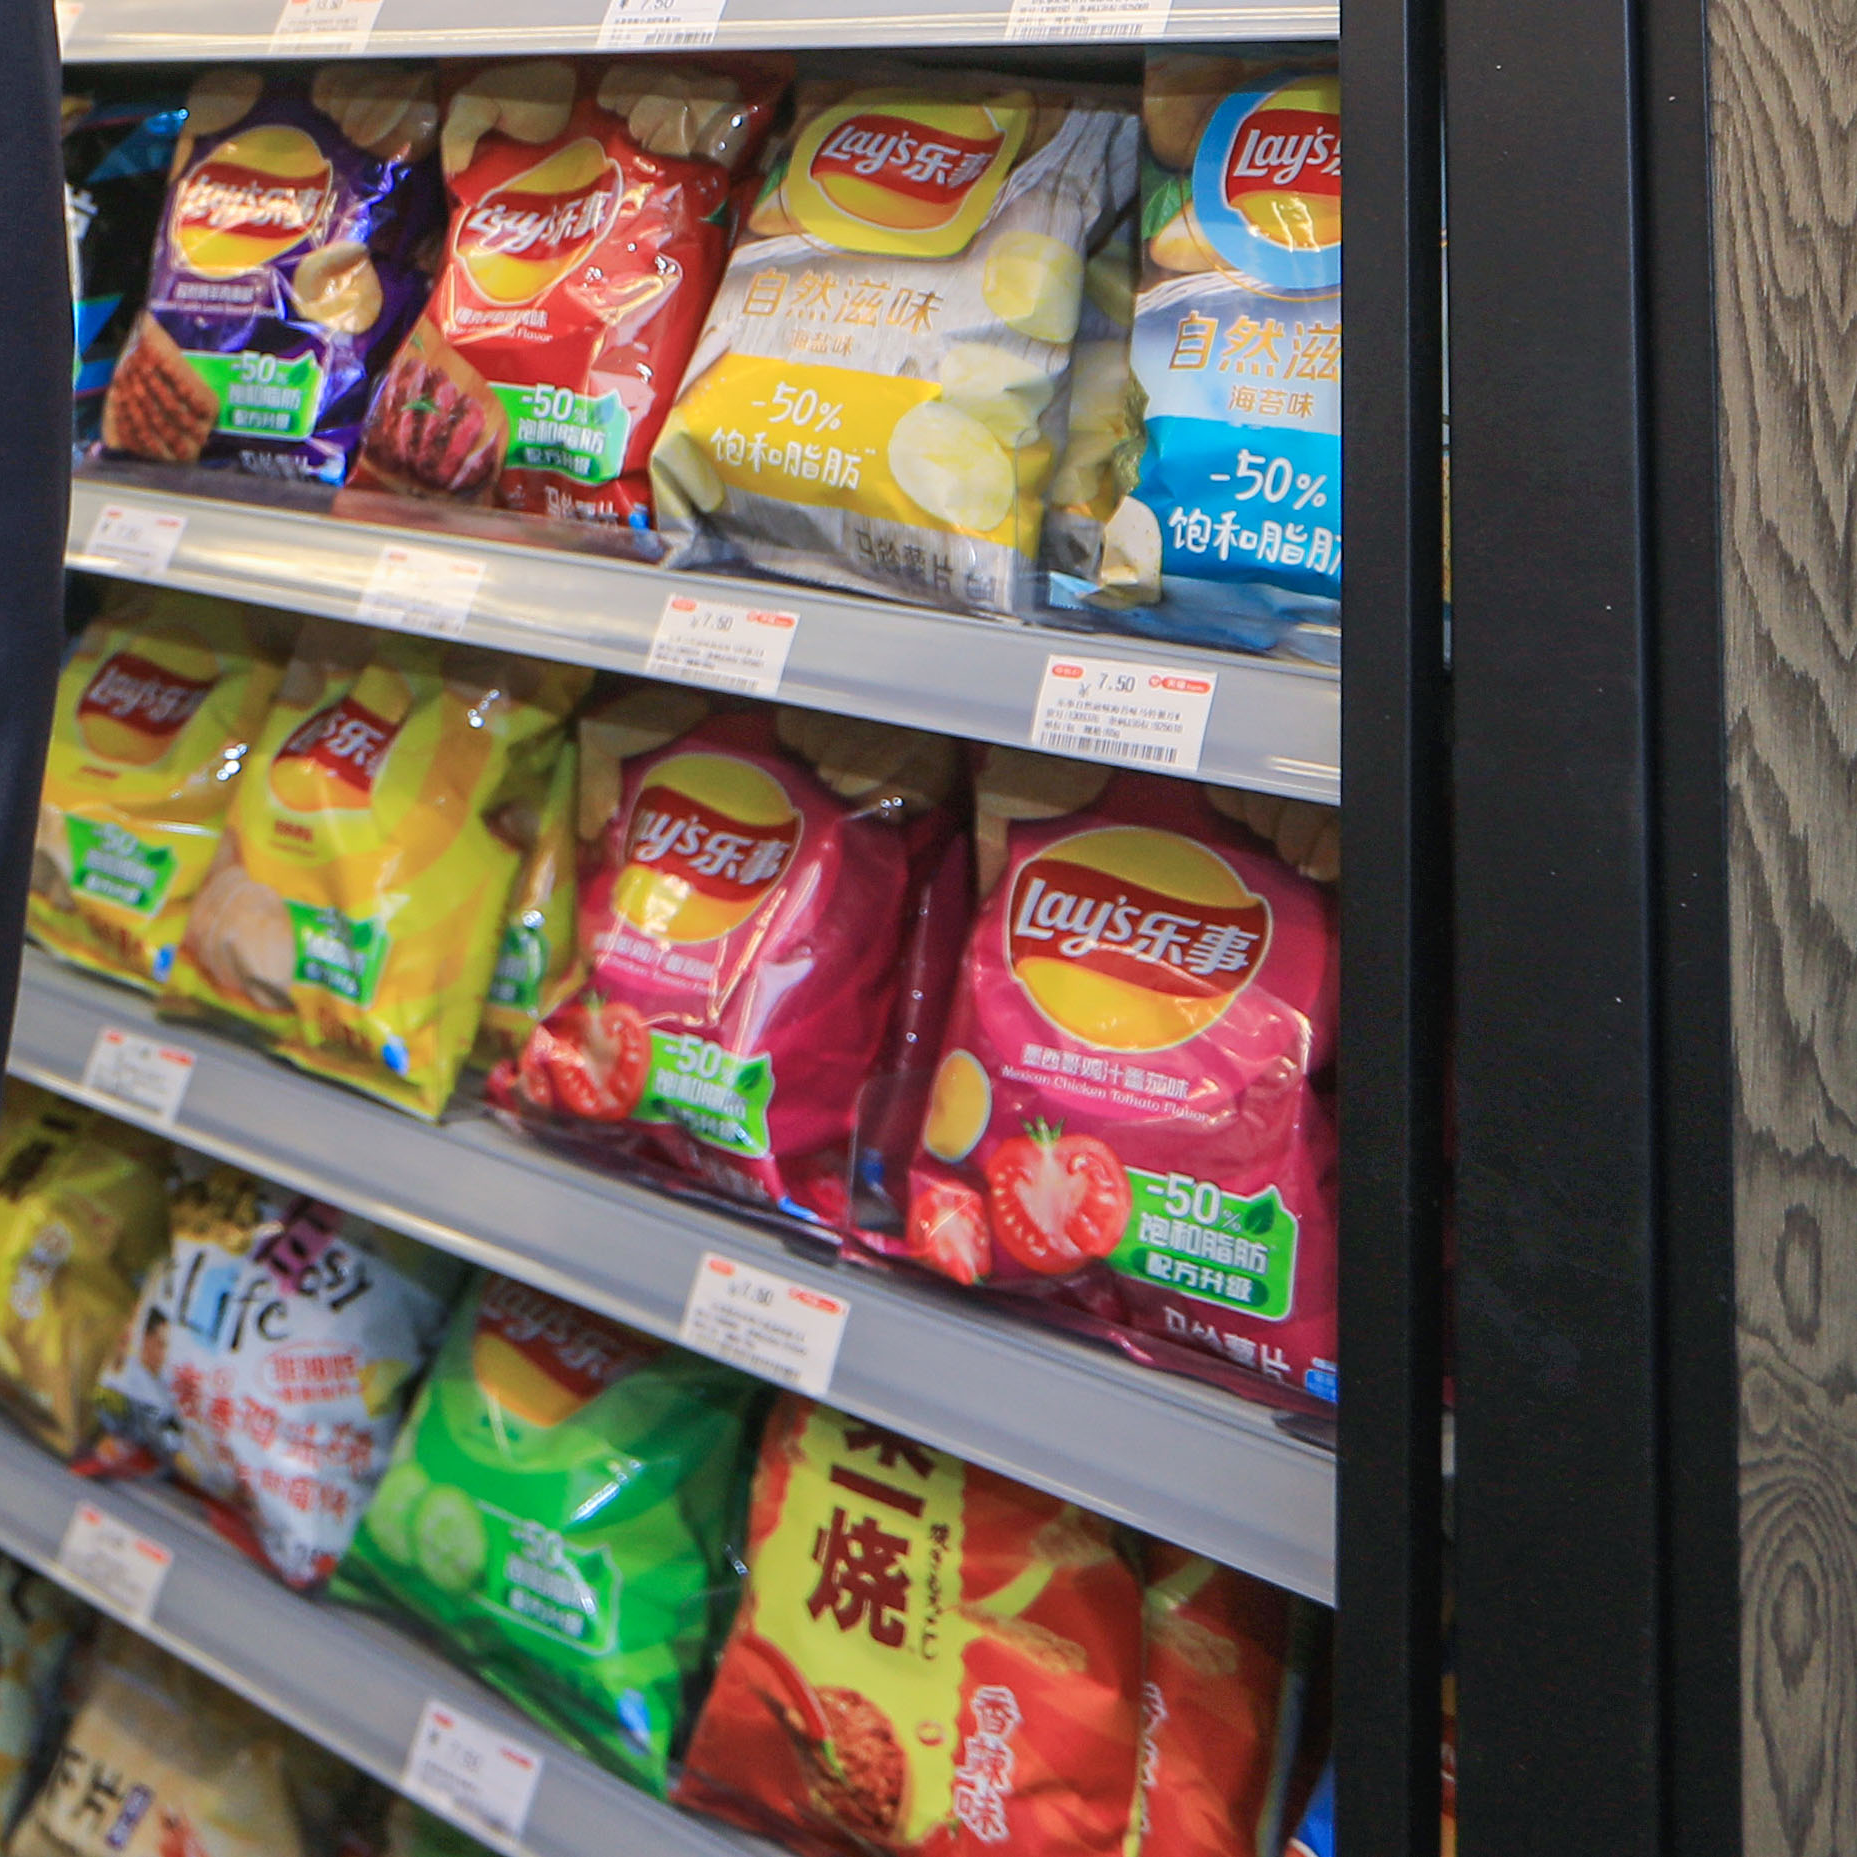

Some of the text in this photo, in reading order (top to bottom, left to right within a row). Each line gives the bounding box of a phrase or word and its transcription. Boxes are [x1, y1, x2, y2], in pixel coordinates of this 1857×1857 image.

[822, 124, 993, 192] Lay's乐事
[742, 268, 945, 336] 自然滋味
[751, 380, 845, 432] -50%
[1229, 384, 1315, 418] 海苔味
[709, 427, 864, 490] 饱和脂肪
[1209, 448, 1330, 511] -50%
[1098, 672, 1136, 693] 7.50
[1015, 877, 1261, 977] Lay's乐事
[1001, 1064, 1051, 1087] Mexican
[1054, 1074, 1107, 1099] Chicken
[1145, 1171, 1243, 1232] -50%
[1138, 1211, 1272, 1276] 饱和脂肪
[1145, 1257, 1255, 1306] 配方升级
